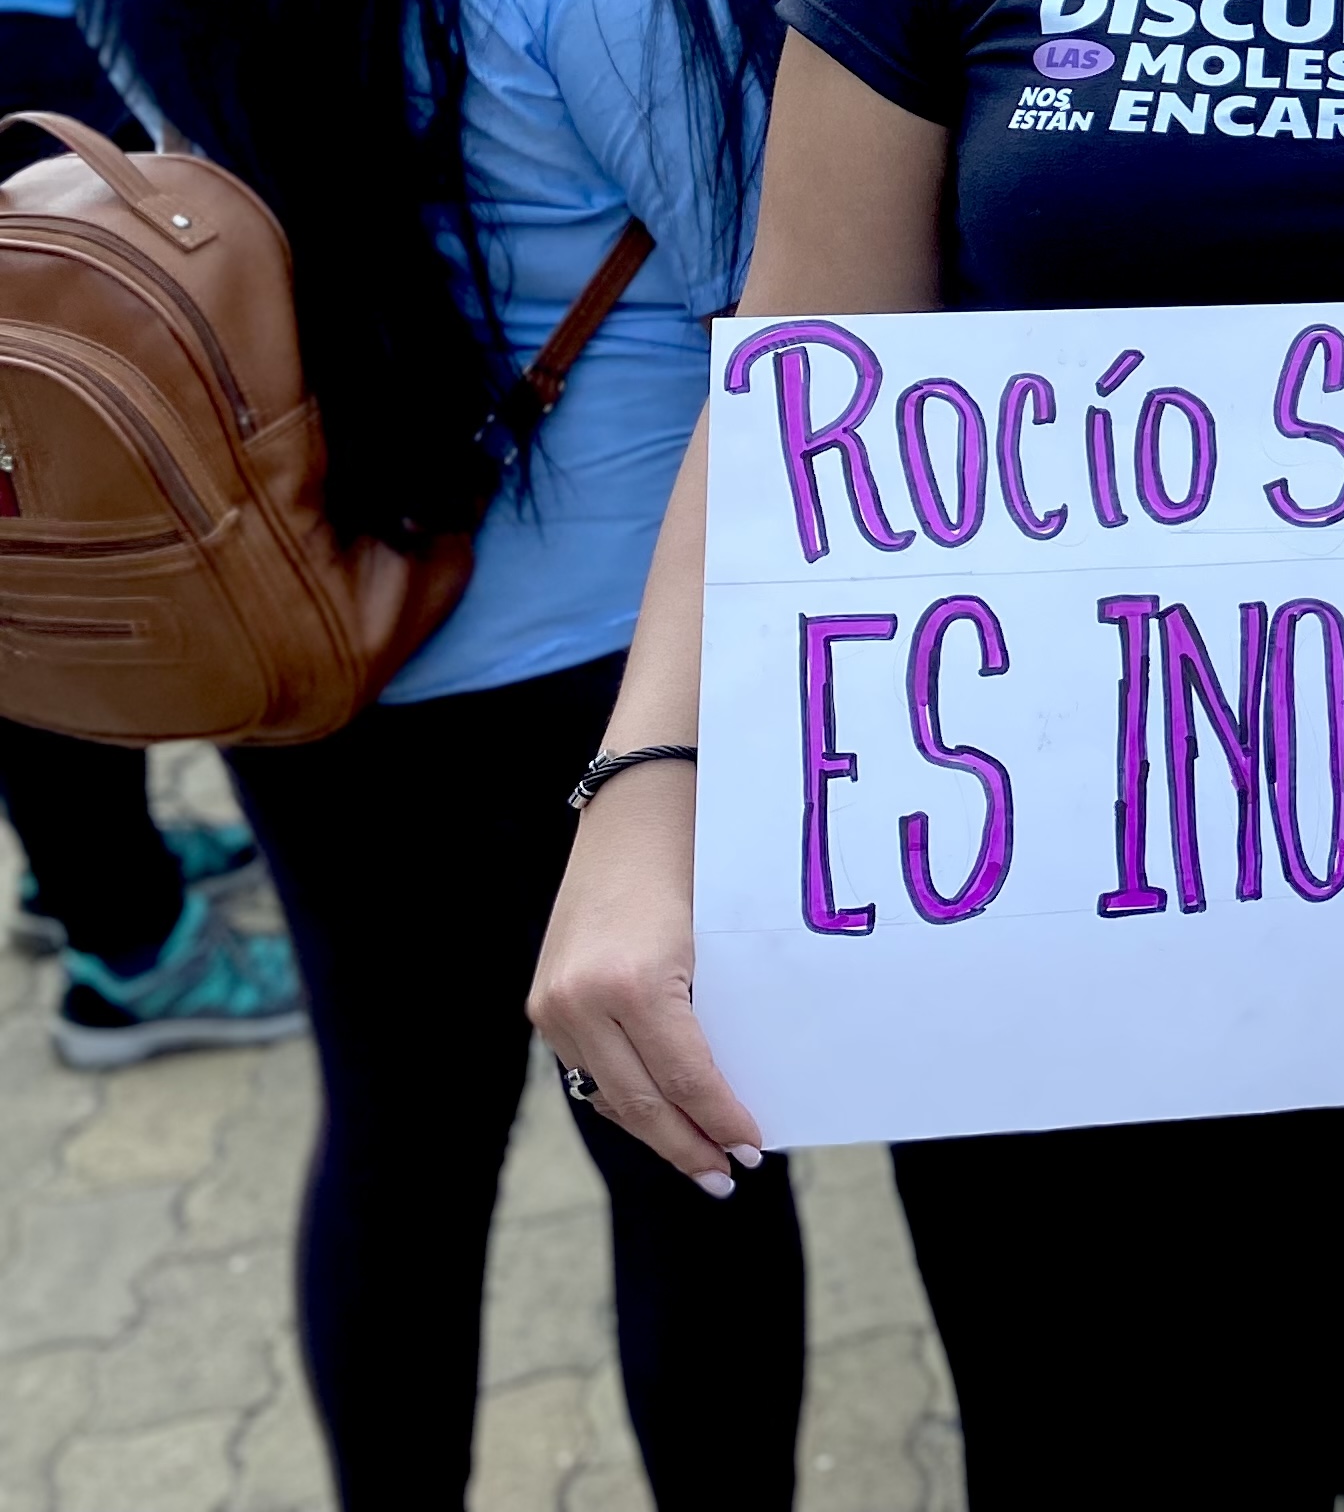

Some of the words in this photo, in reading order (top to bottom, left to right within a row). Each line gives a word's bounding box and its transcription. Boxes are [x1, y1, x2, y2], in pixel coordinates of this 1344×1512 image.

[1046, 46, 1101, 70] LAS
[1018, 87, 1073, 107] NOS
[1007, 103, 1095, 132] ESTÁN
[799, 595, 1014, 936] ES
